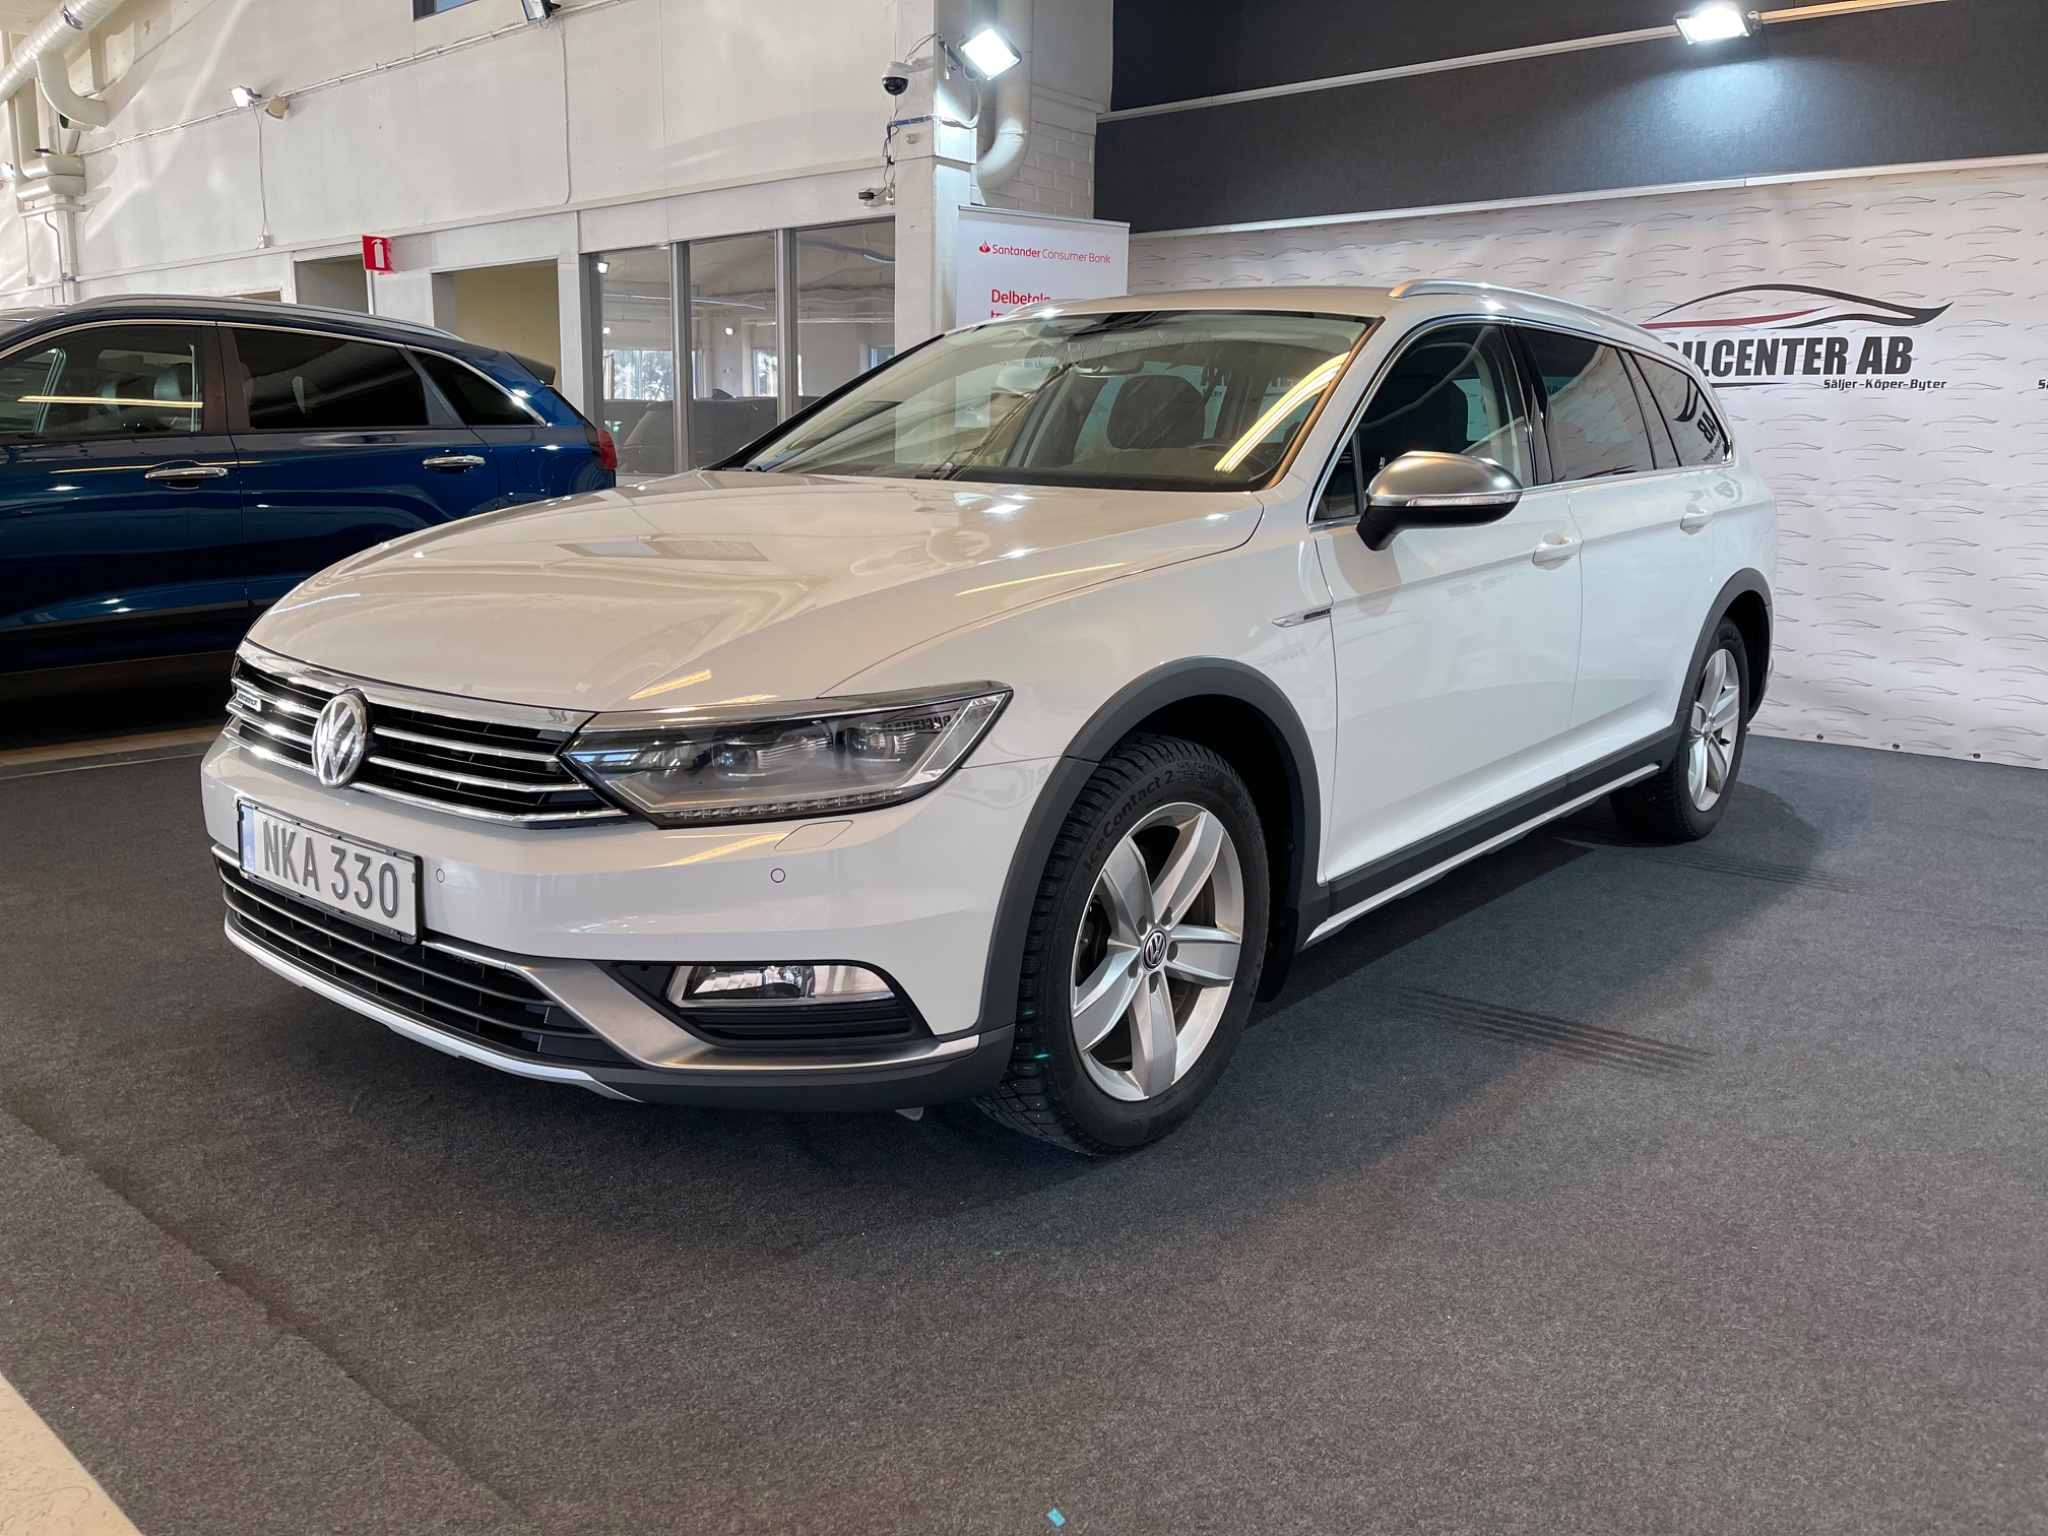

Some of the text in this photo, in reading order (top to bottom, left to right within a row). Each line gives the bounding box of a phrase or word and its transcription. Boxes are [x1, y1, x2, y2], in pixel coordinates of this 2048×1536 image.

[992, 244, 1111, 264] Santander Consumer Bank
[1665, 336, 1913, 377] ILCENTER AB
[1823, 379, 1947, 391] Säljer-Köper-Byter
[1083, 770, 1174, 872] IceContact 2
[262, 817, 398, 918] NKA 330
